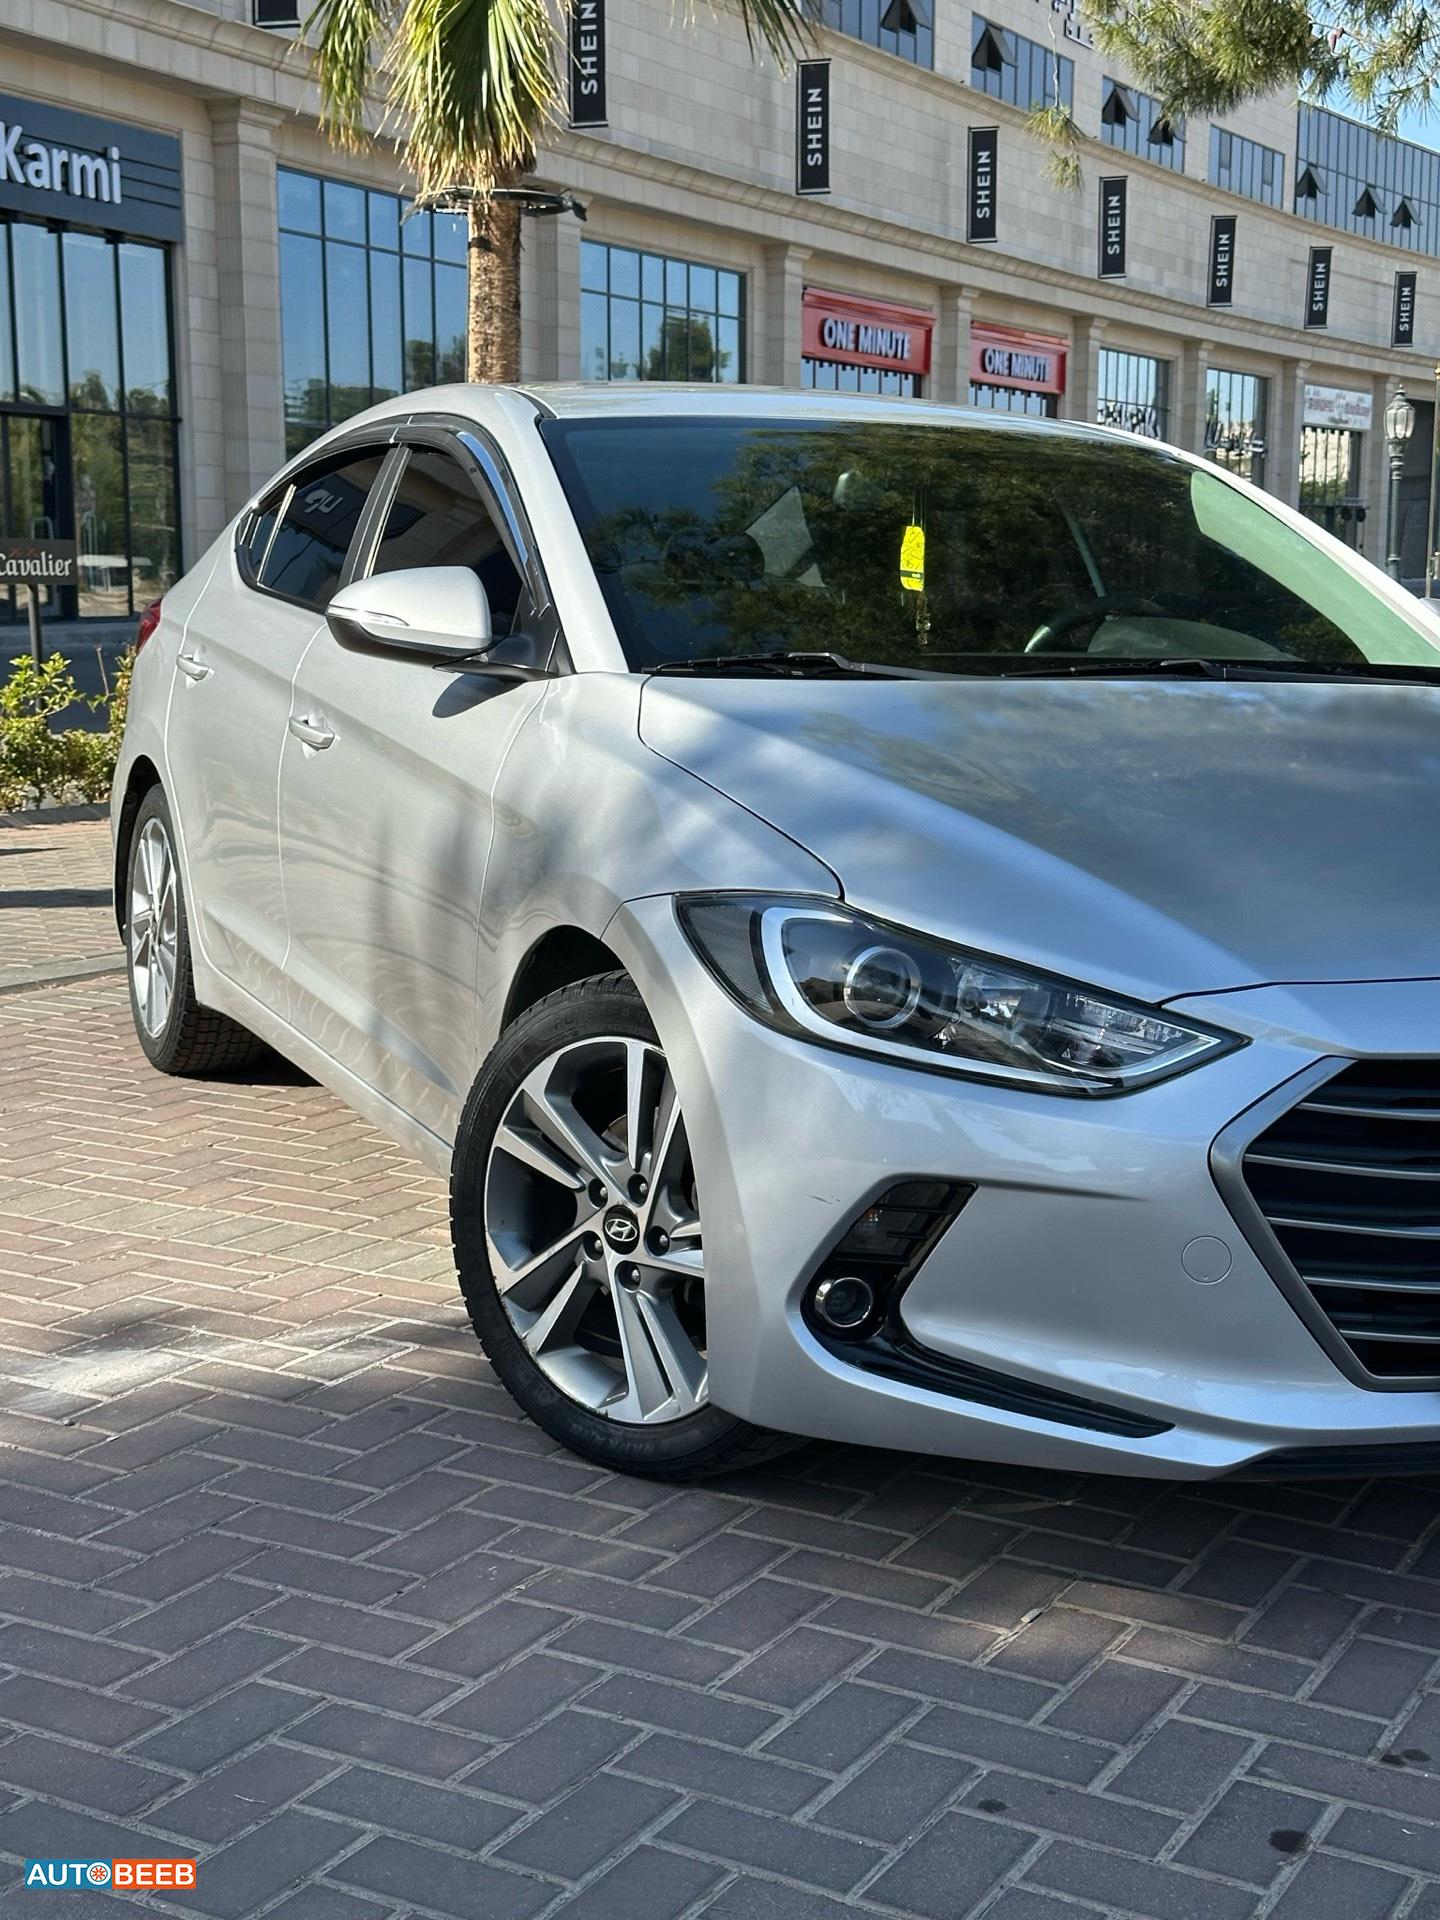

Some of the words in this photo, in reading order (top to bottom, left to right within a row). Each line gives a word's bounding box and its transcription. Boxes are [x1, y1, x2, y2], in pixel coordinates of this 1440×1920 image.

[580, 3, 598, 95] SHEIN
[807, 88, 822, 166] SHEIN
[0, 121, 122, 204] Karmi
[977, 151, 991, 218] SHEIN
[1107, 195, 1121, 255] SHEIN
[1215, 233, 1230, 287] SHEIN
[1312, 263, 1326, 311] SHEIN
[1399, 287, 1411, 331] SHEIN
[823, 317, 856, 350] ONE
[857, 325, 911, 361] MINUTE
[984, 348, 1010, 375] ONE
[1011, 353, 1050, 383] MINUTE
[0, 551, 72, 576] Cavalier
